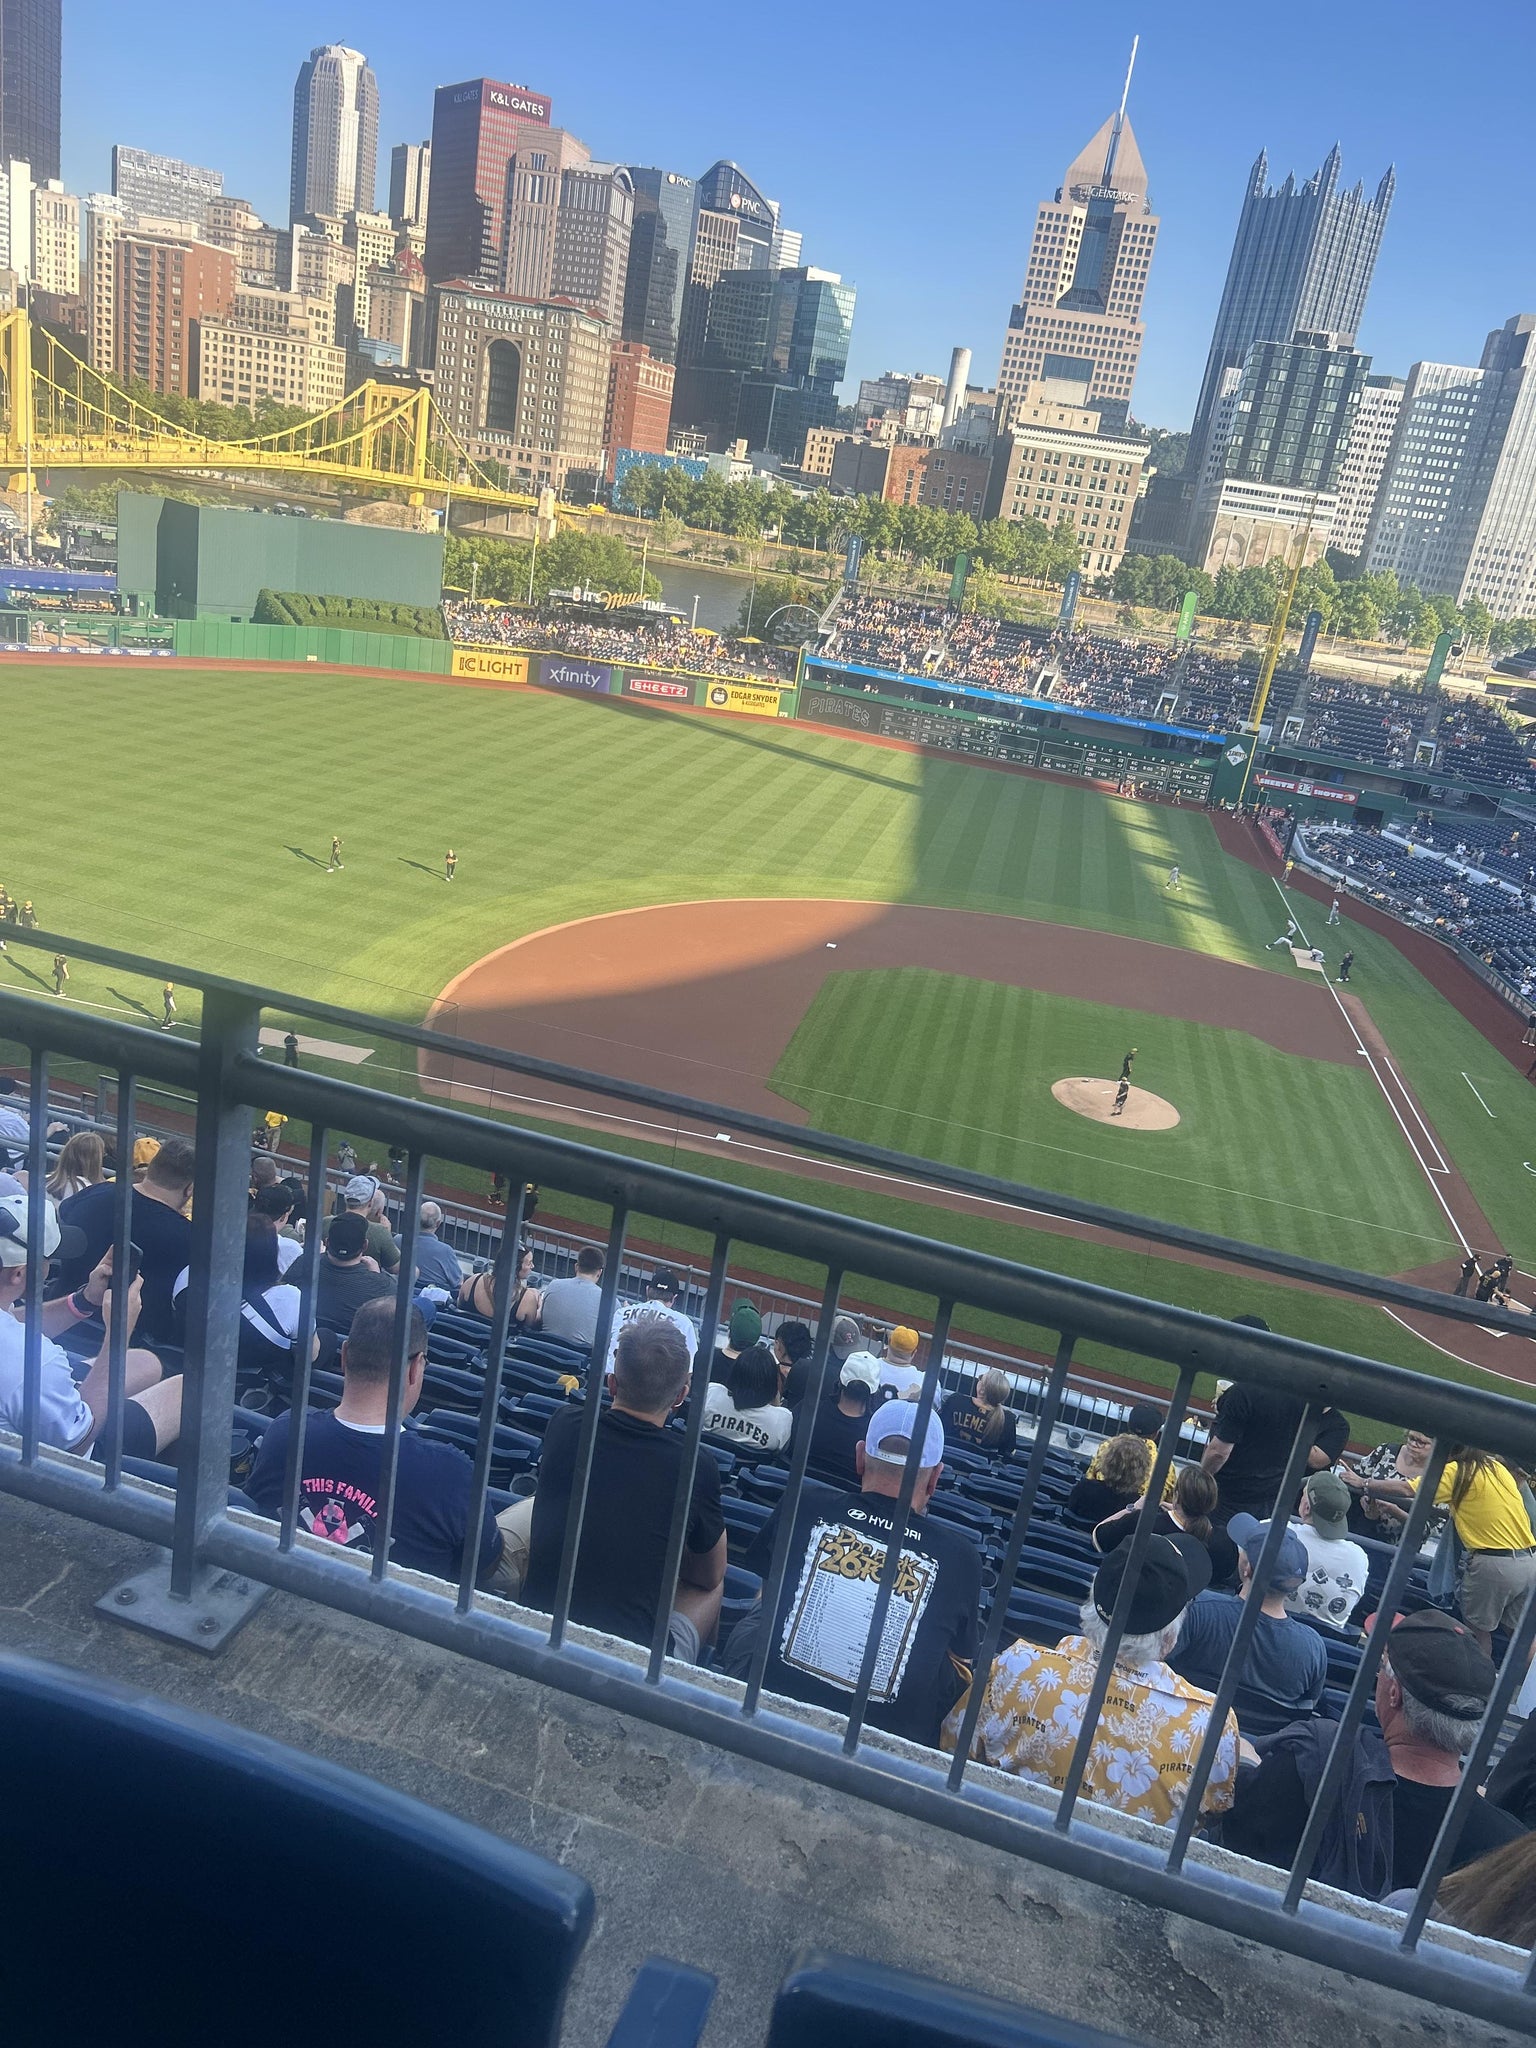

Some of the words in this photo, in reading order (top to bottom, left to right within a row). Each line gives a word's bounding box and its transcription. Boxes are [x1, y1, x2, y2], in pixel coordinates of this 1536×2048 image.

[490, 91, 510, 106] K&L
[511, 97, 544, 116] GATES
[676, 177, 692, 188] PNC
[741, 197, 761, 214] PNC
[583, 590, 601, 603] IT'S
[599, 590, 651, 611] Miller
[642, 600, 667, 611] TIME
[459, 656, 476, 671] IC
[479, 660, 523, 676] LIGHT
[549, 666, 601, 688] xfinity
[634, 681, 684, 695] SHEETZ
[730, 690, 752, 701] EDGAR
[752, 694, 778, 704] SNYDER
[808, 697, 870, 727] PIRATES
[977, 715, 1002, 726] WELCOME
[1064, 739, 1133, 757] AMERICAN
[1142, 755, 1194, 769] LEAGUE
[710, 1413, 770, 1446] PIRATES
[953, 1411, 987, 1433] CLEME
[302, 1478, 334, 1493] THIS
[868, 1514, 922, 1542] HYUDAI
[1103, 1695, 1136, 1713] RATES
[1012, 1716, 1046, 1733] PIRATES
[1159, 1763, 1193, 1775] PIRATE
[1053, 1775, 1095, 1794] PIES
